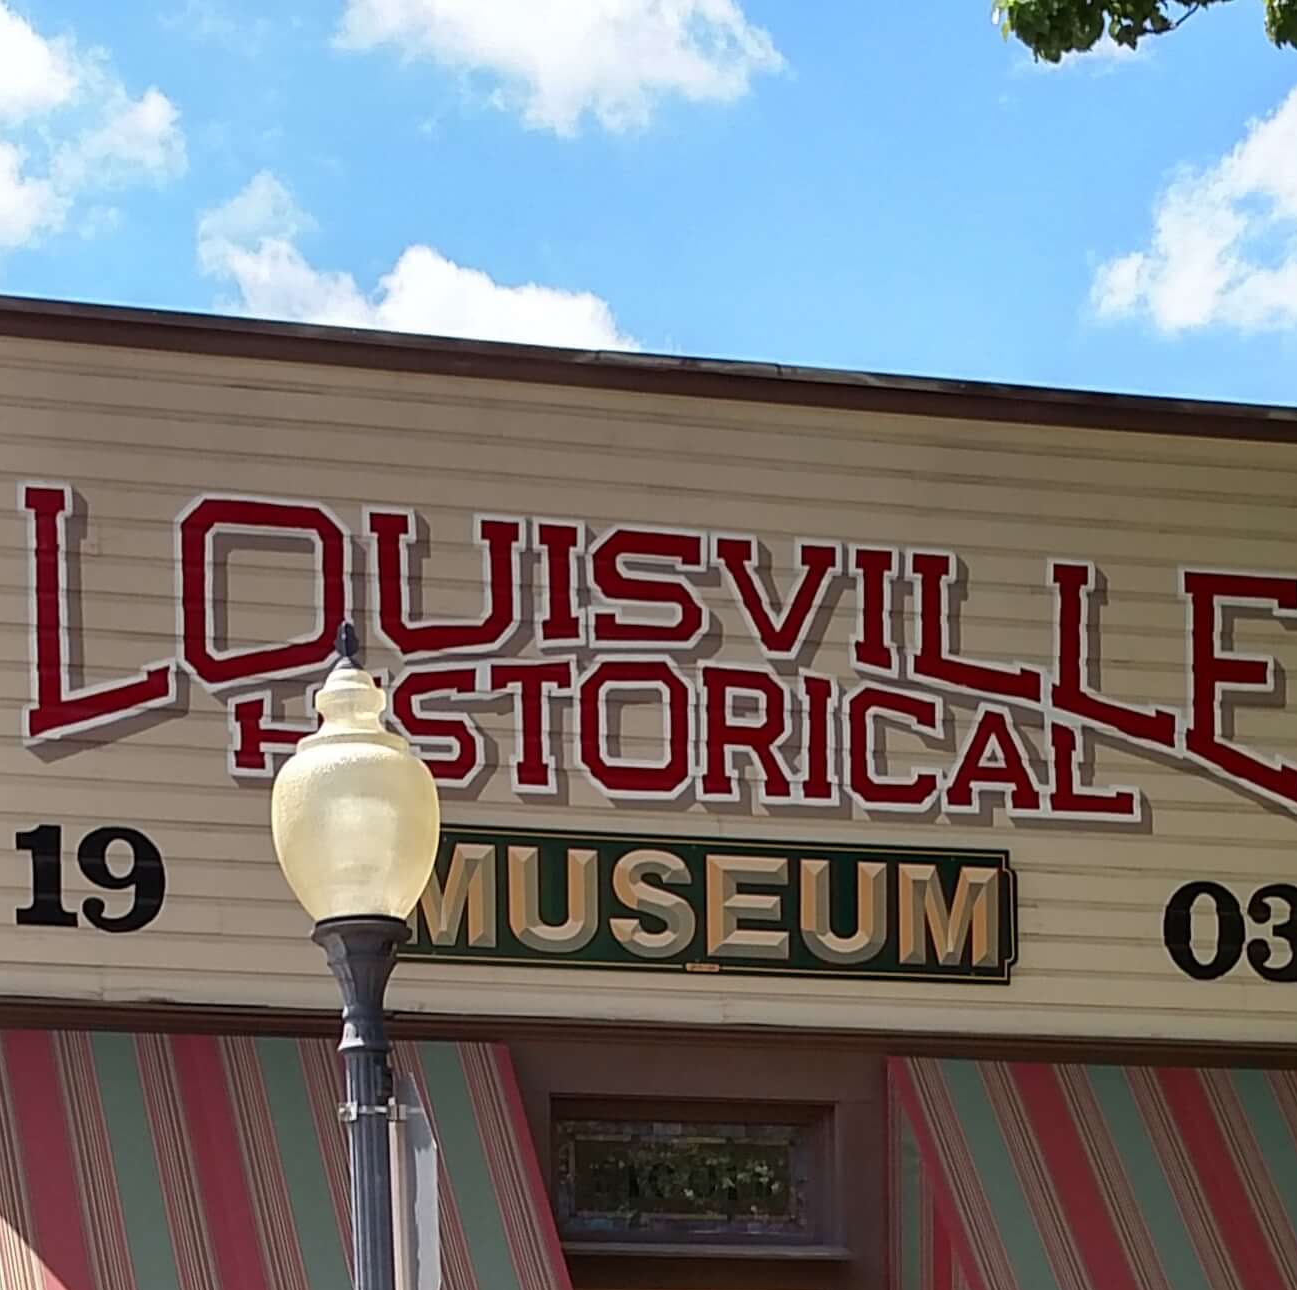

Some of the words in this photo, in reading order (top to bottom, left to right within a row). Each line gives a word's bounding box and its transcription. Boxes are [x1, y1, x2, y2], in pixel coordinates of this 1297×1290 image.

[228, 652, 1141, 821] HSTORICAL
[15, 824, 167, 933] 19
[410, 842, 999, 967] MUSEUM
